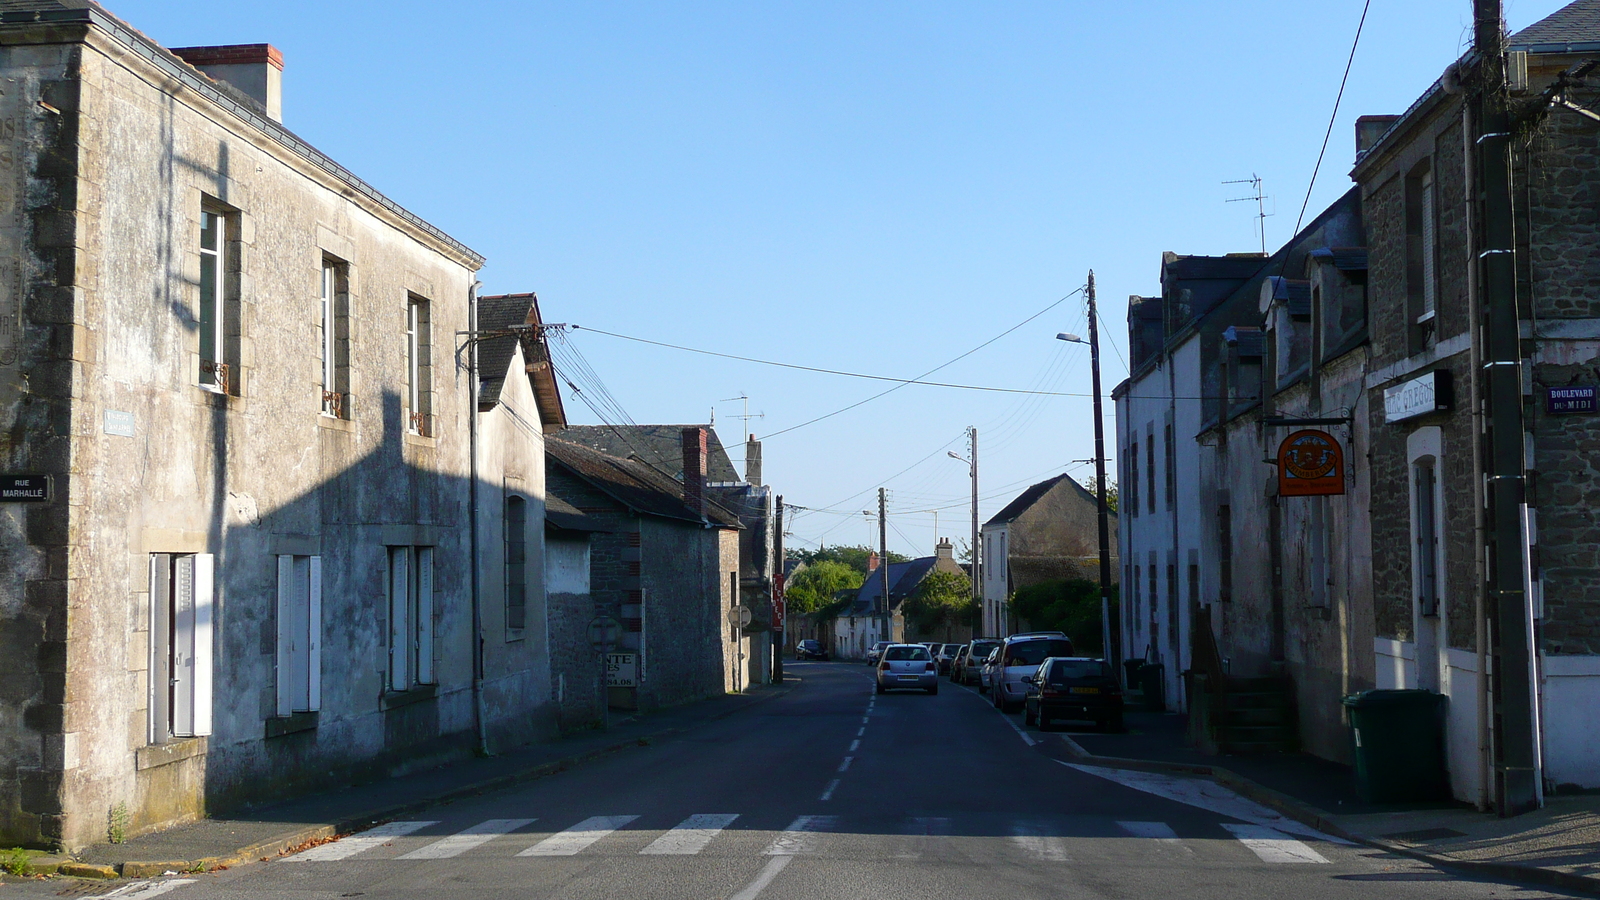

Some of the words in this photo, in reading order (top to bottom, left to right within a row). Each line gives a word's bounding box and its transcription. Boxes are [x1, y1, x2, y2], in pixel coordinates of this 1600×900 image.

[1551, 388, 1593, 399] BOULEVARD
[1287, 460, 1334, 478] GRIMBERGEN
[14, 479, 30, 487] RUE
[2, 488, 43, 497] MARHALLÉ
